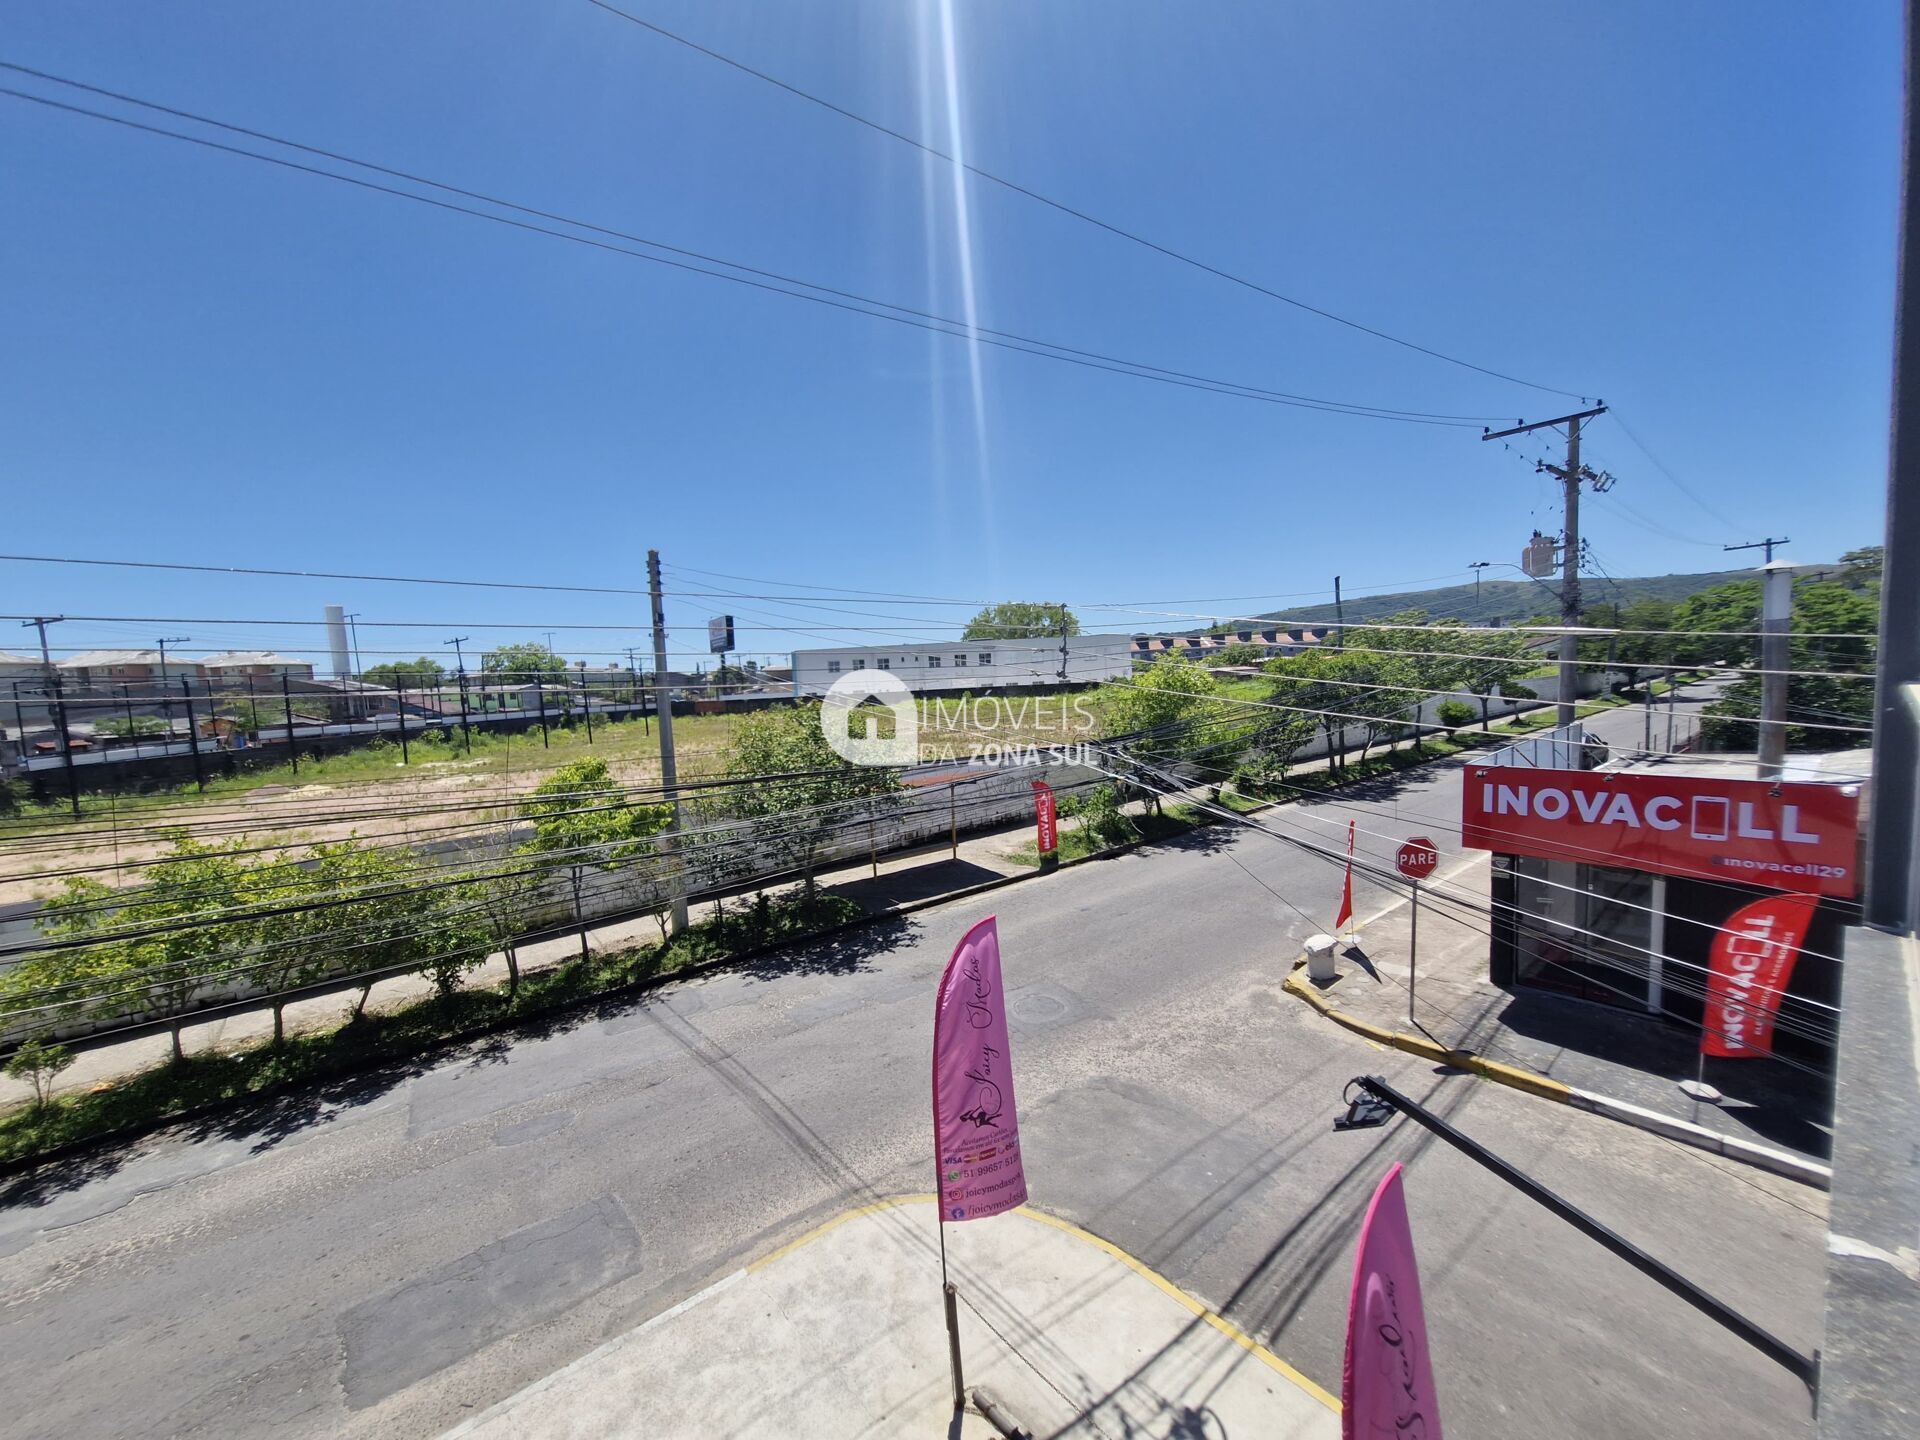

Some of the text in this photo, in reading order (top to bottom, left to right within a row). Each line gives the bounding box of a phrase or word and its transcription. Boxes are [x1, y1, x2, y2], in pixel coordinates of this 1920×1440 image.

[1400, 852, 1436, 866] PARE
[945, 1156, 963, 1165] VISA
[963, 1168, 975, 1178] 51
[977, 1160, 1003, 1176] 99657
